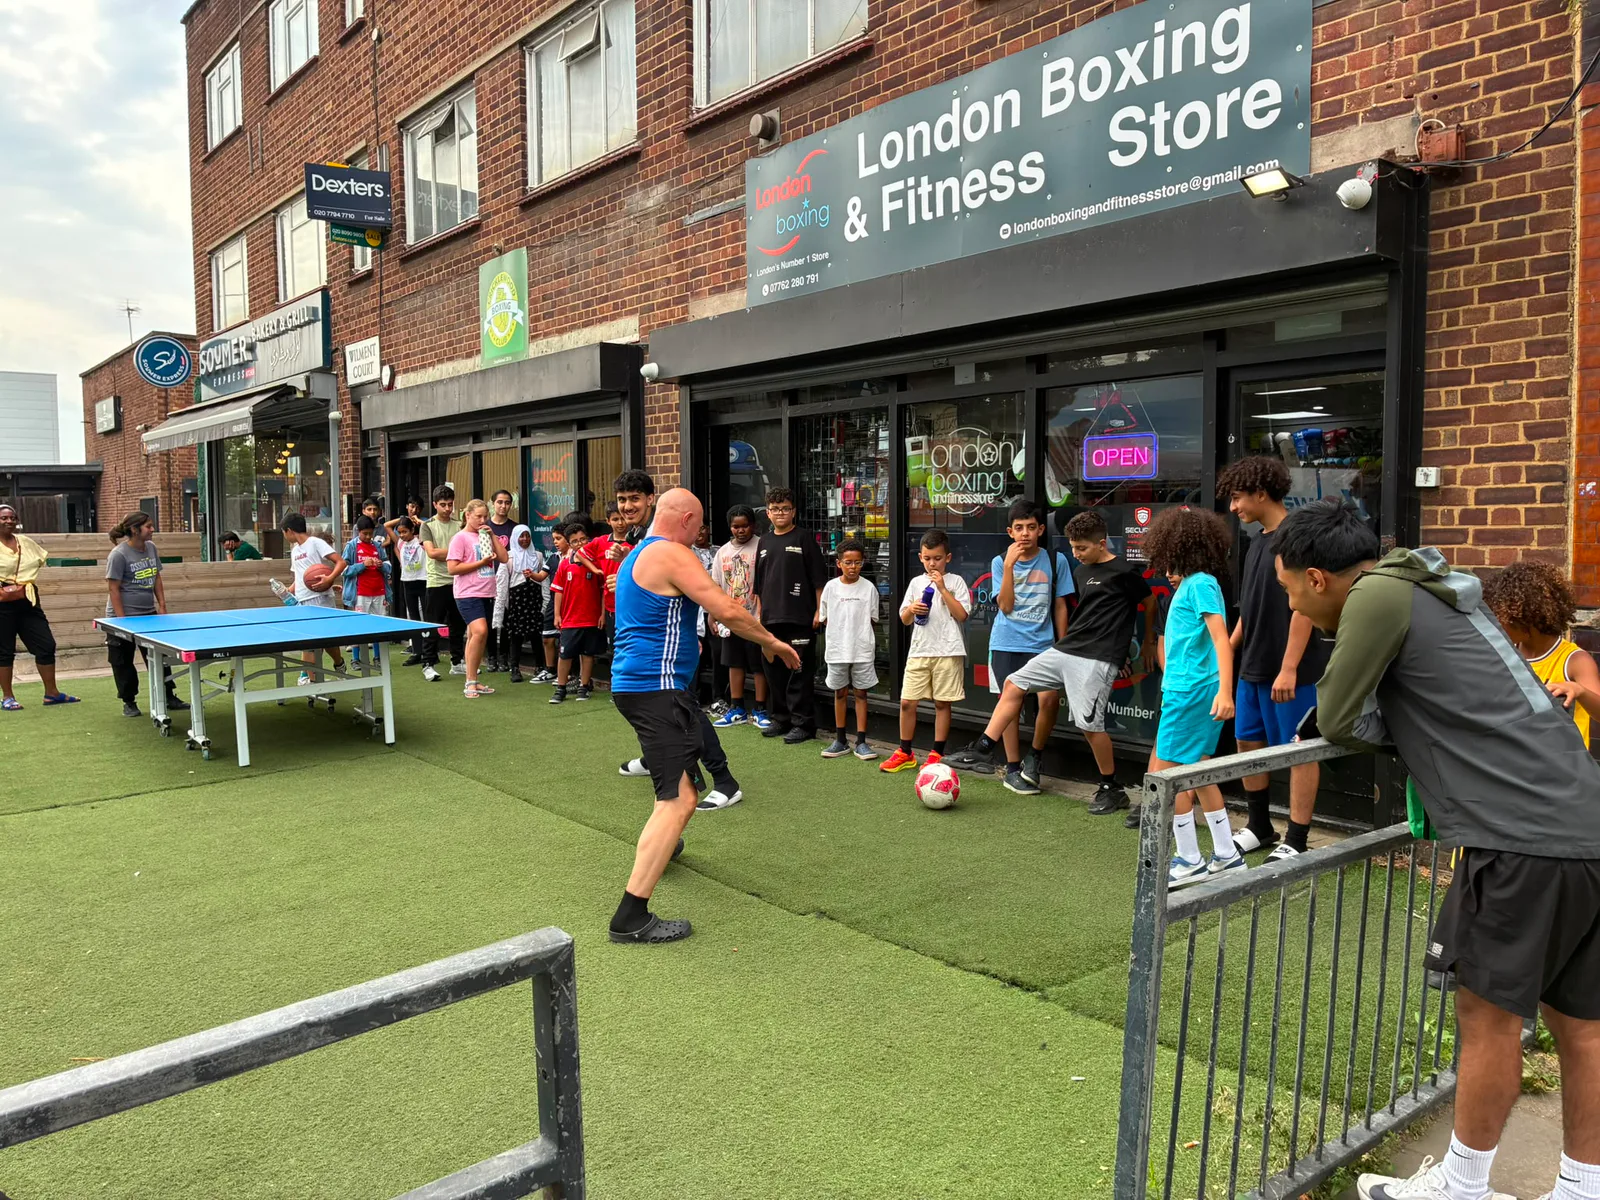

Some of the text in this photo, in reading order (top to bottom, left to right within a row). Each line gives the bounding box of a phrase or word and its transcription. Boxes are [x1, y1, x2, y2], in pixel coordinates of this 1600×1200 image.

[857, 2, 1251, 179] London Boxing
[843, 78, 1282, 243] & Fitness Store
[311, 173, 384, 198] Dexters
[755, 173, 812, 210] London
[776, 203, 830, 235] boxing
[366, 232, 380, 240] SALE
[756, 251, 829, 278] London's Number 1 Store
[769, 272, 819, 293] 07762 280 791
[491, 301, 511, 315] BOXING
[251, 306, 309, 342] BAKERY & GRILL
[200, 336, 248, 375] SOUMER
[348, 342, 377, 363] WILMENT
[142, 358, 162, 381] SOUMER
[162, 365, 185, 382] EXPRESS
[213, 369, 245, 388] EXPRESS
[352, 361, 375, 379] COURT
[921, 434, 1015, 469] London
[1091, 446, 1149, 468] OPEN
[533, 465, 567, 484] London
[931, 467, 1004, 497] boxing
[546, 491, 575, 510] boxing
[1107, 701, 1155, 720] Number
